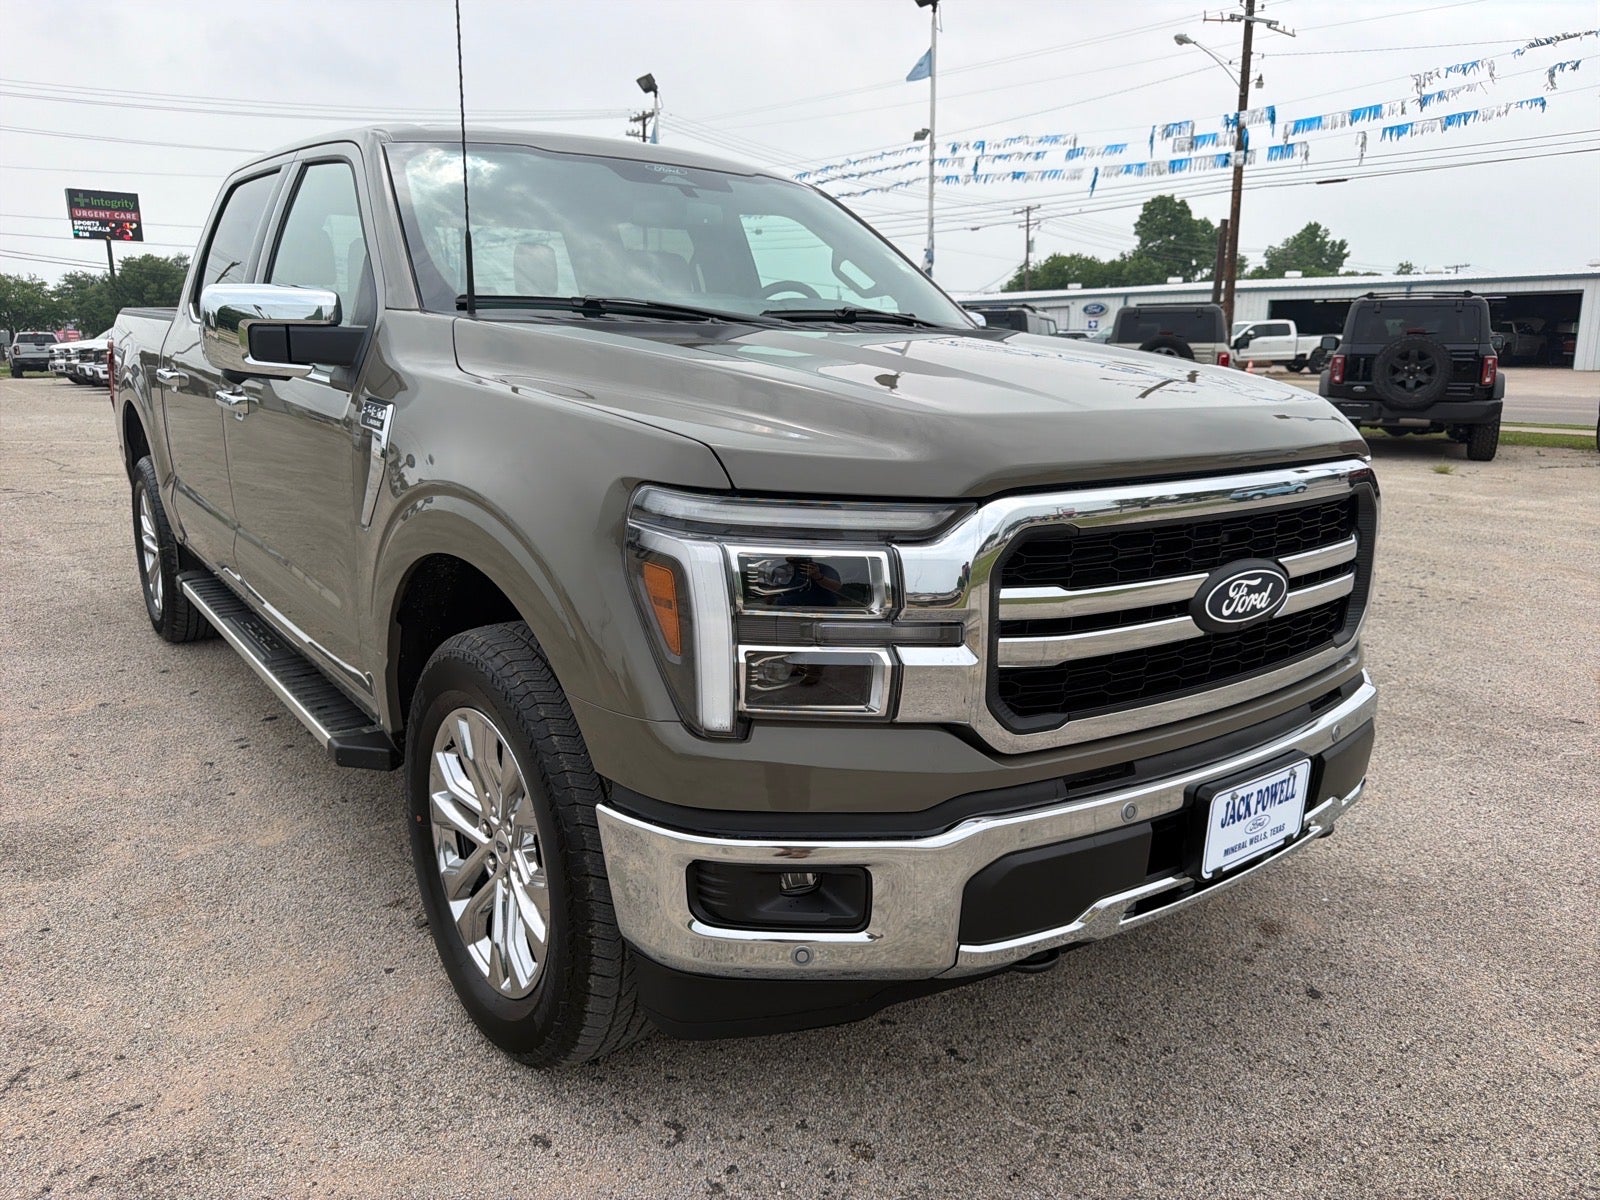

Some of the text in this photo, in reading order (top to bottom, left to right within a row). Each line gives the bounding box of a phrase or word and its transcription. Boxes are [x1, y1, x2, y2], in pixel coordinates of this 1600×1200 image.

[75, 210, 137, 220] URGENT CARE
[90, 197, 135, 209] Integrity
[1221, 577, 1274, 617] Ford
[1220, 773, 1297, 829] JACK POWELL
[1223, 823, 1286, 857] MINERAL WELLS, TEXAS
